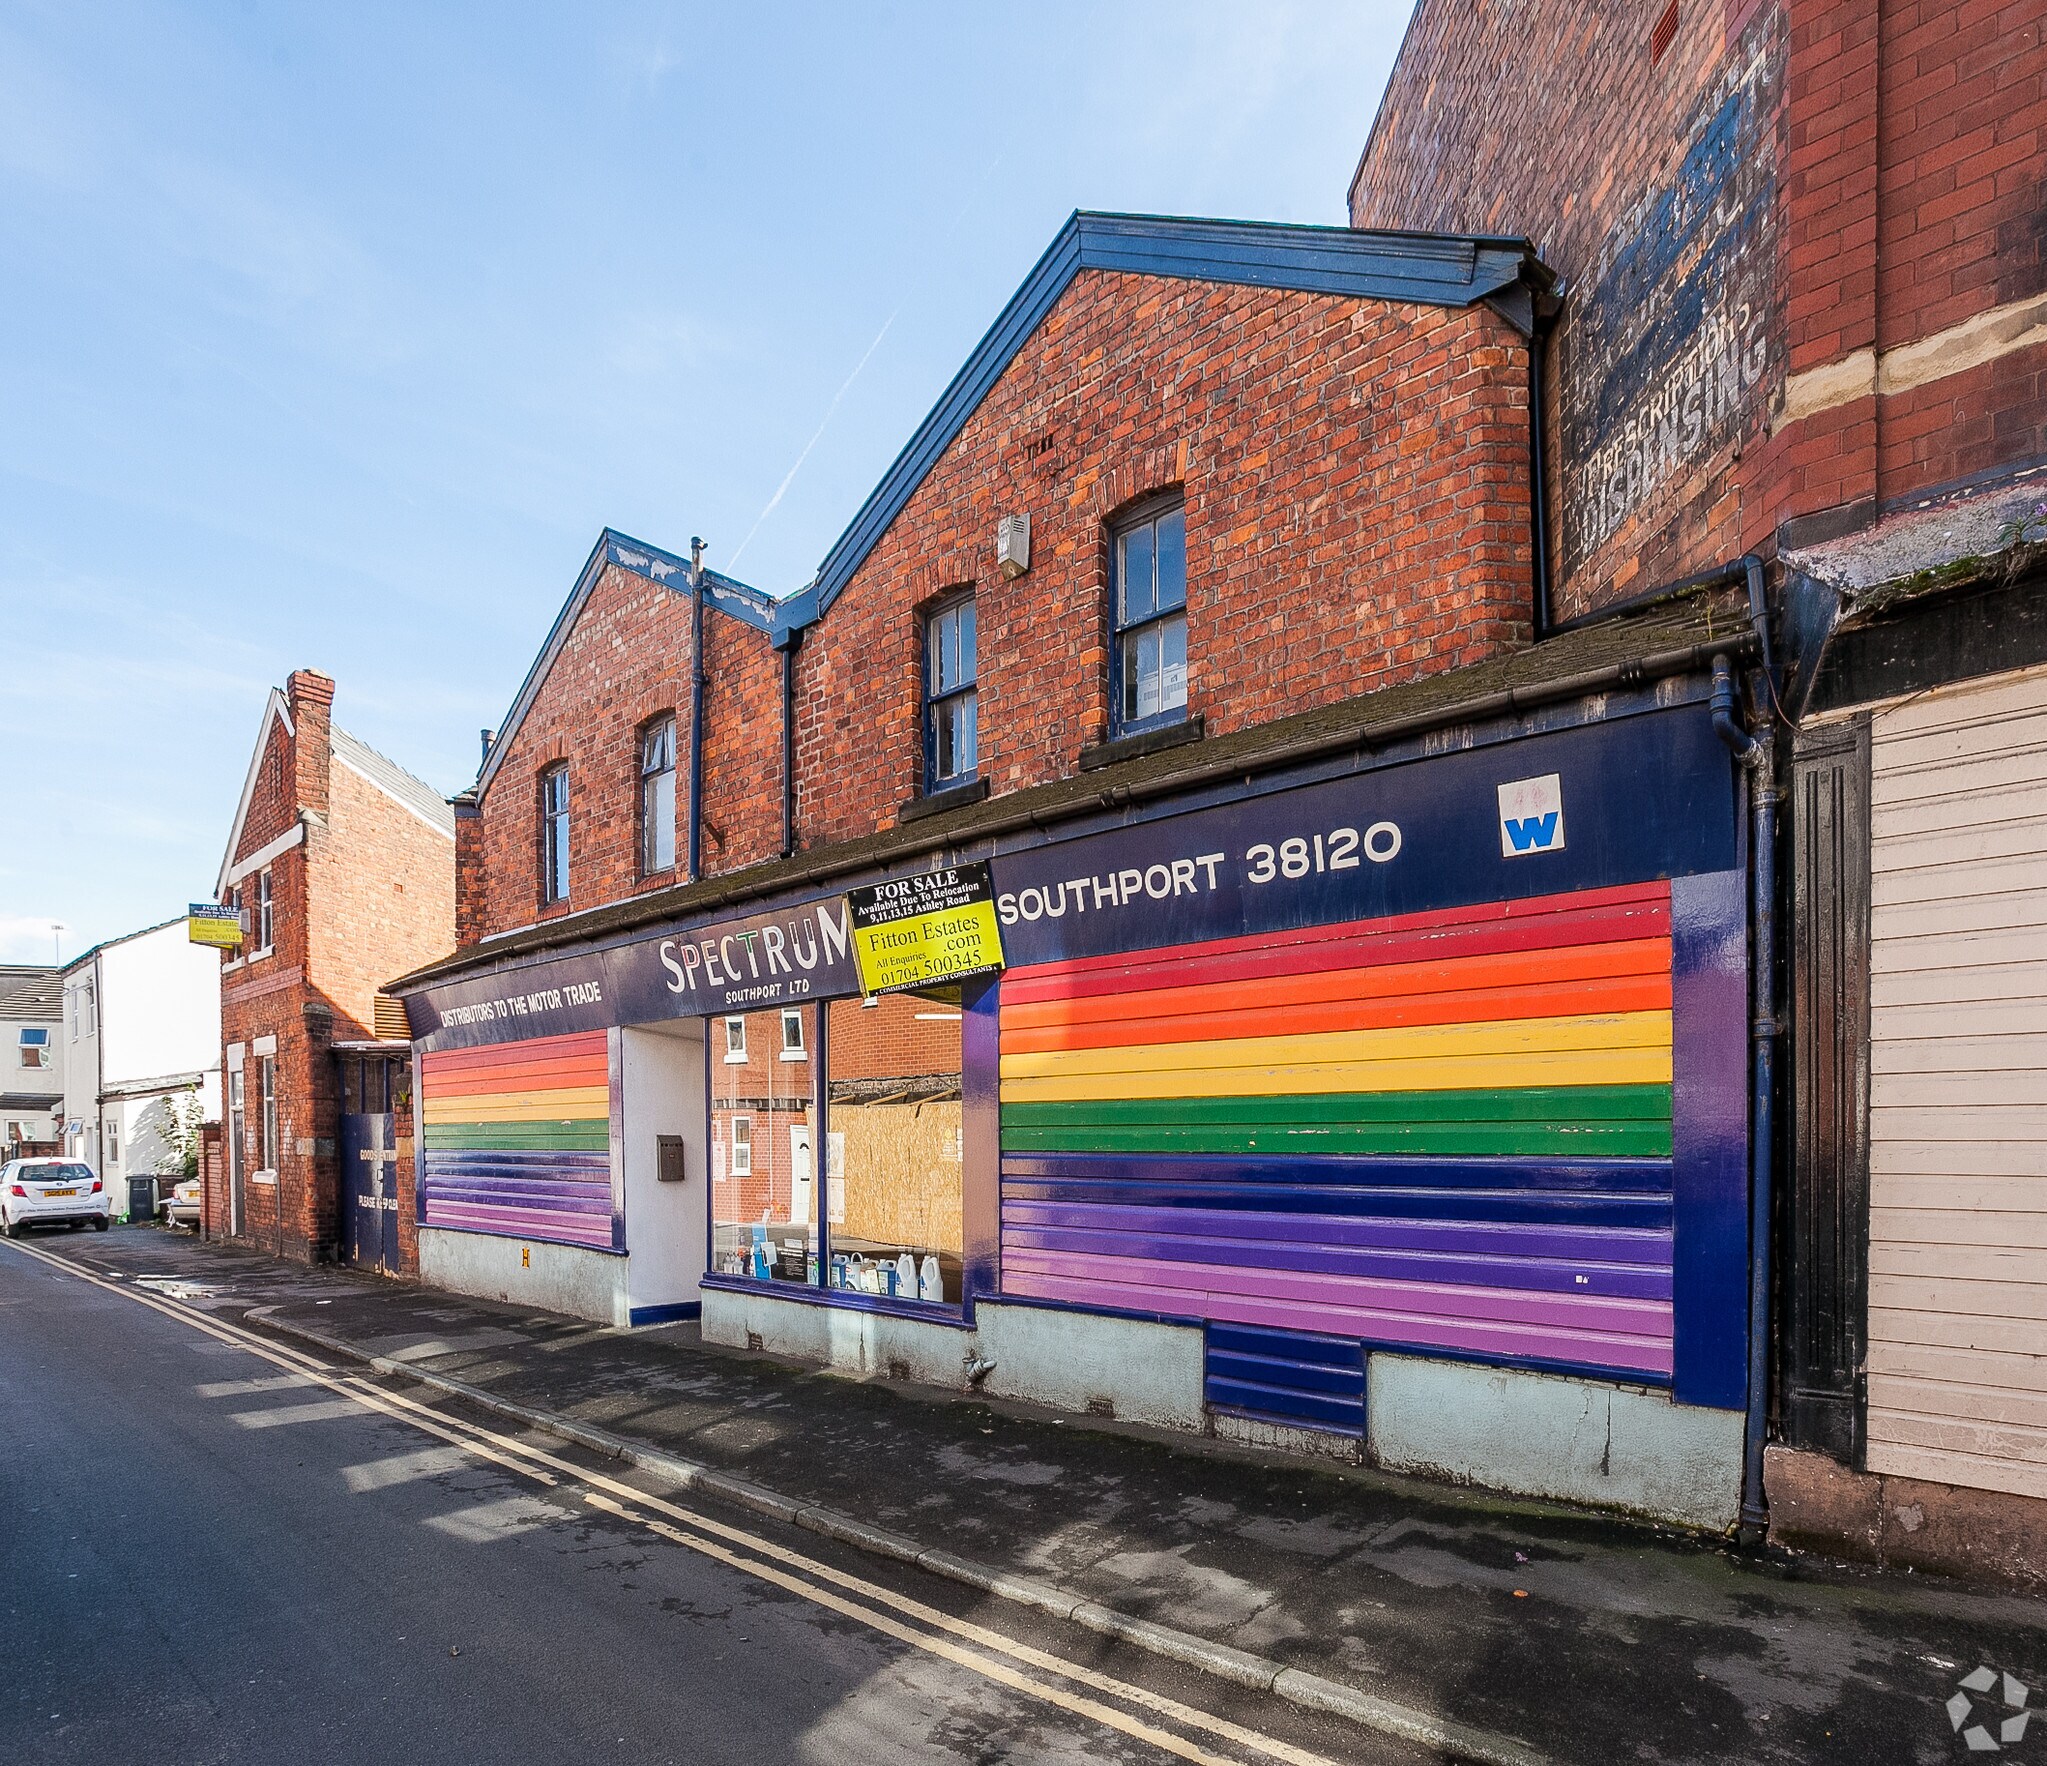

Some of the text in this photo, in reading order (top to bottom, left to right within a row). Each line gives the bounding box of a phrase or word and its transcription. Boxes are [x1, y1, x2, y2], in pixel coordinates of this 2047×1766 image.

[1503, 811, 1560, 851] W
[874, 869, 959, 901] FOR SALE
[999, 821, 1403, 926] SOUTHPORT 38120
[858, 881, 980, 916] Available Due To Relocation
[870, 893, 971, 923] 9,11,13,15 Ashley Road
[659, 900, 849, 994] SPECTRUM
[869, 916, 980, 952] Fitton Estates
[943, 933, 982, 952] .com
[876, 951, 927, 969] All Enquiries
[881, 949, 982, 986] 01704 500345
[725, 978, 810, 1005] SOUTHPORT LTD
[879, 965, 993, 995] COMMERCIAL PROPERTY CONSULTANTS
[440, 981, 602, 1028] DISTRIBUTORS TO THE MOTOR TRADE
[358, 1194, 376, 1208] PLEASE
